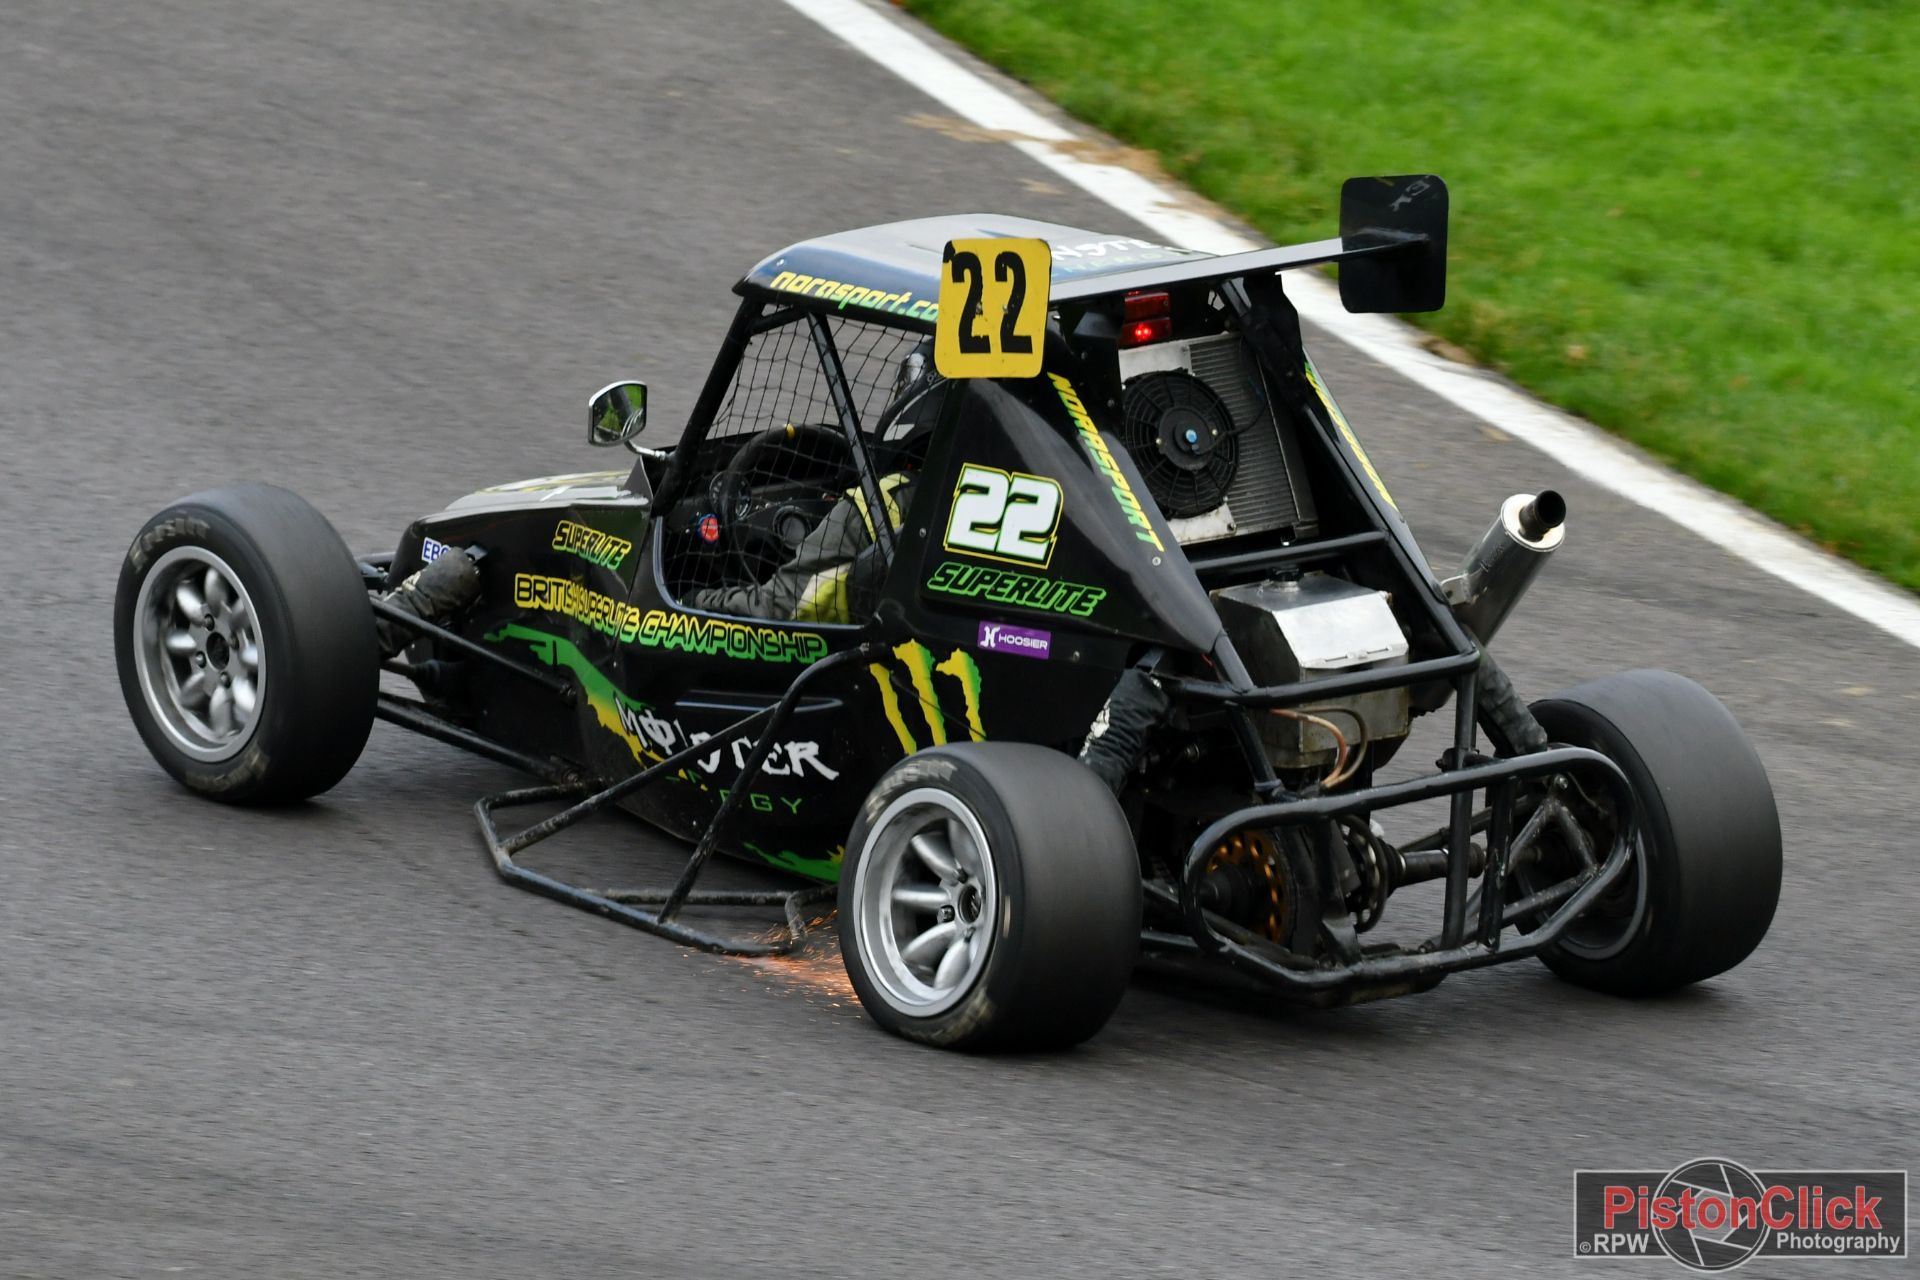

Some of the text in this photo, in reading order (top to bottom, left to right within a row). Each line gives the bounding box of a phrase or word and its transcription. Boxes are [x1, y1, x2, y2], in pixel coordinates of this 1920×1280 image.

[951, 251, 1033, 354] 22
[943, 464, 1062, 566] 22
[553, 520, 632, 570] SUPERLITE
[928, 562, 1106, 616] SUPERLITE
[639, 609, 828, 664] CHAMPIONSHIP
[999, 633, 1048, 650] HOOSIER
